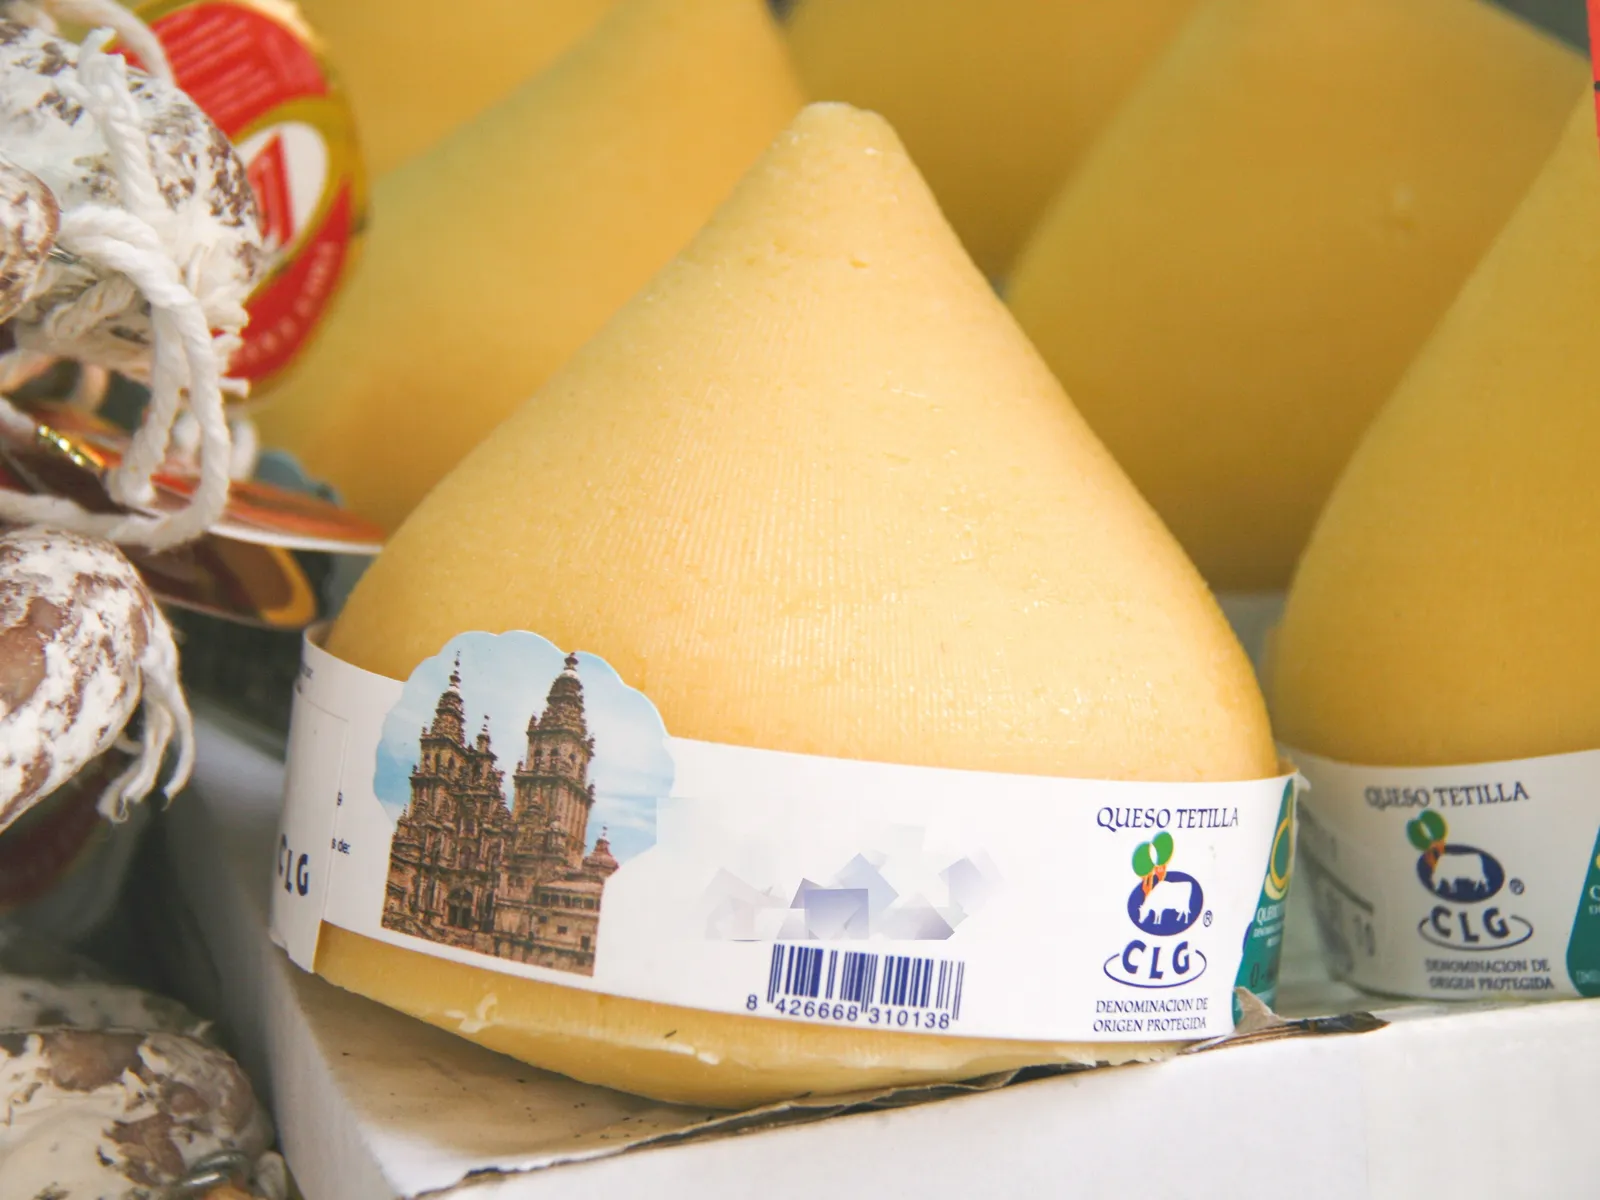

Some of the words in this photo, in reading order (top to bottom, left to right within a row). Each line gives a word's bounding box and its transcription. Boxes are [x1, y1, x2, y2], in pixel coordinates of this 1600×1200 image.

[1364, 786, 1431, 810] QUESO
[1433, 780, 1530, 808] TETILLA
[1096, 806, 1171, 832] QUESO
[1175, 807, 1239, 829] TETILLA
[1430, 904, 1511, 943] CLG
[1122, 939, 1190, 980] CLG
[1425, 958, 1528, 973] DENOMINACION
[1530, 958, 1551, 973] DE
[1428, 976, 1475, 991] ORIGEN
[1477, 976, 1555, 991] PROTEGIDA
[745, 993, 759, 1012] 8
[774, 996, 859, 1022] 426668
[868, 1006, 951, 1030] 310138
[1095, 998, 1194, 1014] DENOMINACION
[1195, 997, 1209, 1011] DE
[1093, 1017, 1144, 1033] ORIGEN
[1146, 1016, 1207, 1032] PROTEGIDA
